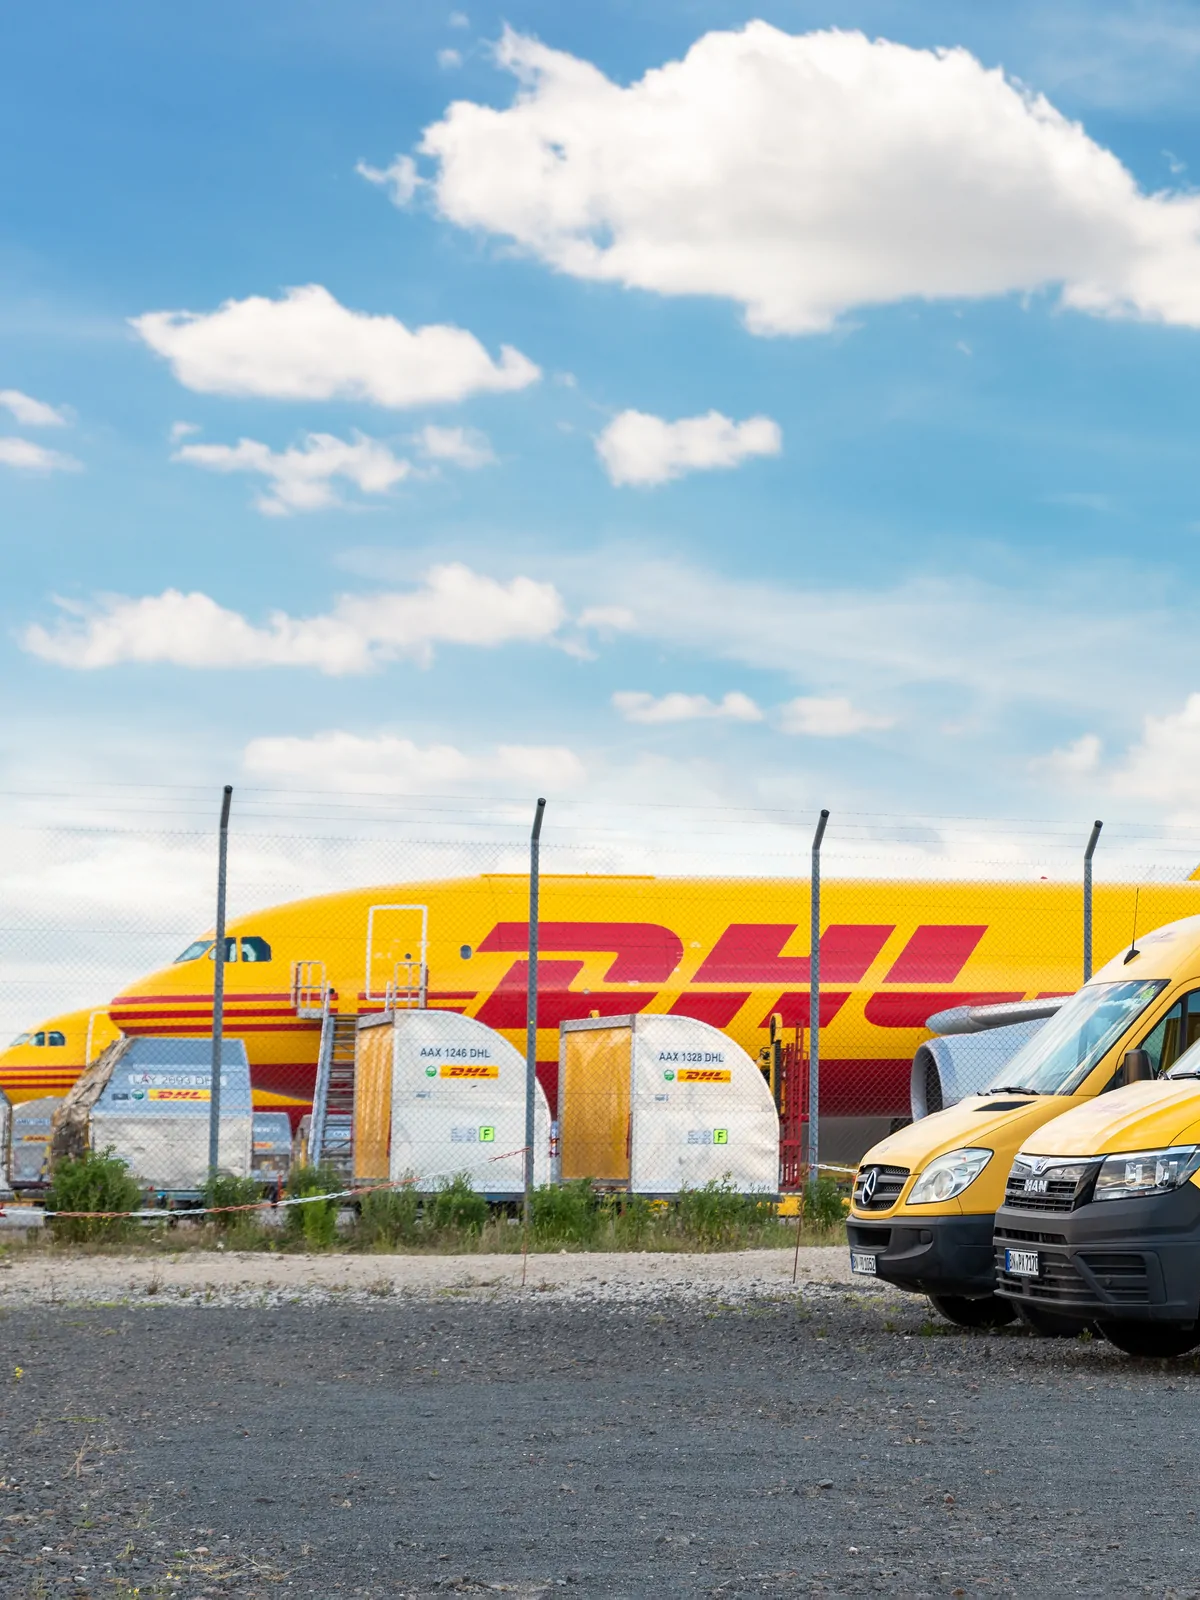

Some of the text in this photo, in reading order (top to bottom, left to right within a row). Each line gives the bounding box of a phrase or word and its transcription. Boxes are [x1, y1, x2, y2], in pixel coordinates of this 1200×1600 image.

[471, 921, 1027, 1029] DHL
[420, 1047, 490, 1058] AAX 1246 DHL
[659, 1052, 724, 1063] AAX 1328 DHL
[449, 1067, 490, 1077] DHL
[685, 1071, 724, 1080] DHL
[194, 1076, 213, 1086] DH
[157, 1091, 202, 1099] DHL
[483, 1128, 491, 1140] F
[717, 1131, 724, 1142] F
[1023, 1179, 1048, 1193] MAN
